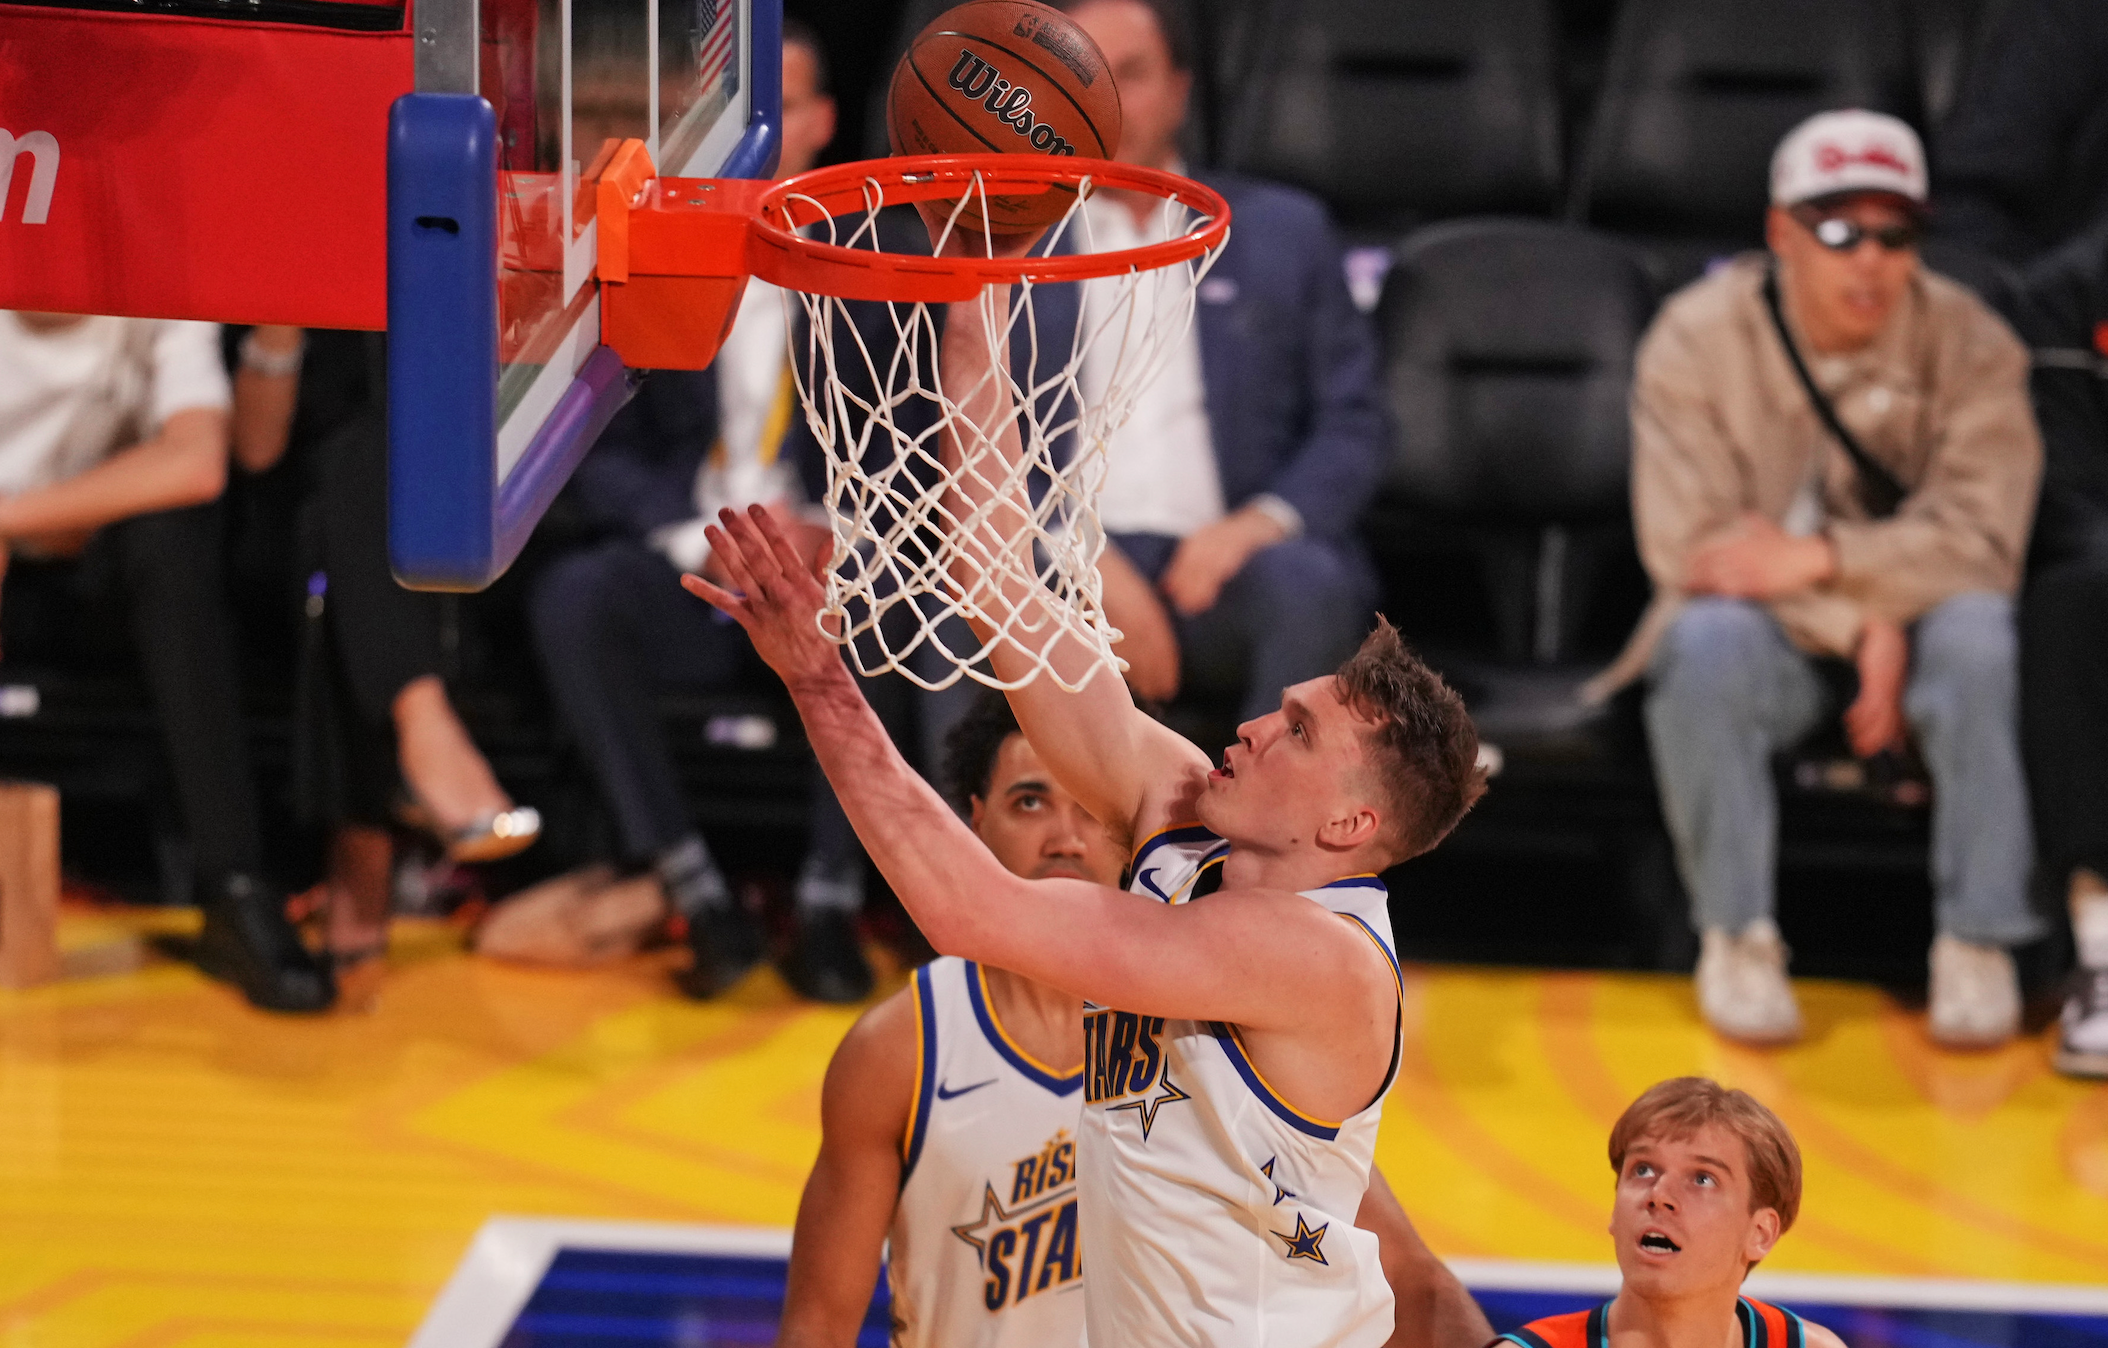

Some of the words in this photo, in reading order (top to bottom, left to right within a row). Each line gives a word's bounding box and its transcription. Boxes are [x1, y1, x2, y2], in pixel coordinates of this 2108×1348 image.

[947, 48, 1076, 157] Wilson
[1008, 1139, 1076, 1206] RIS
[984, 1196, 1083, 1314] STA
